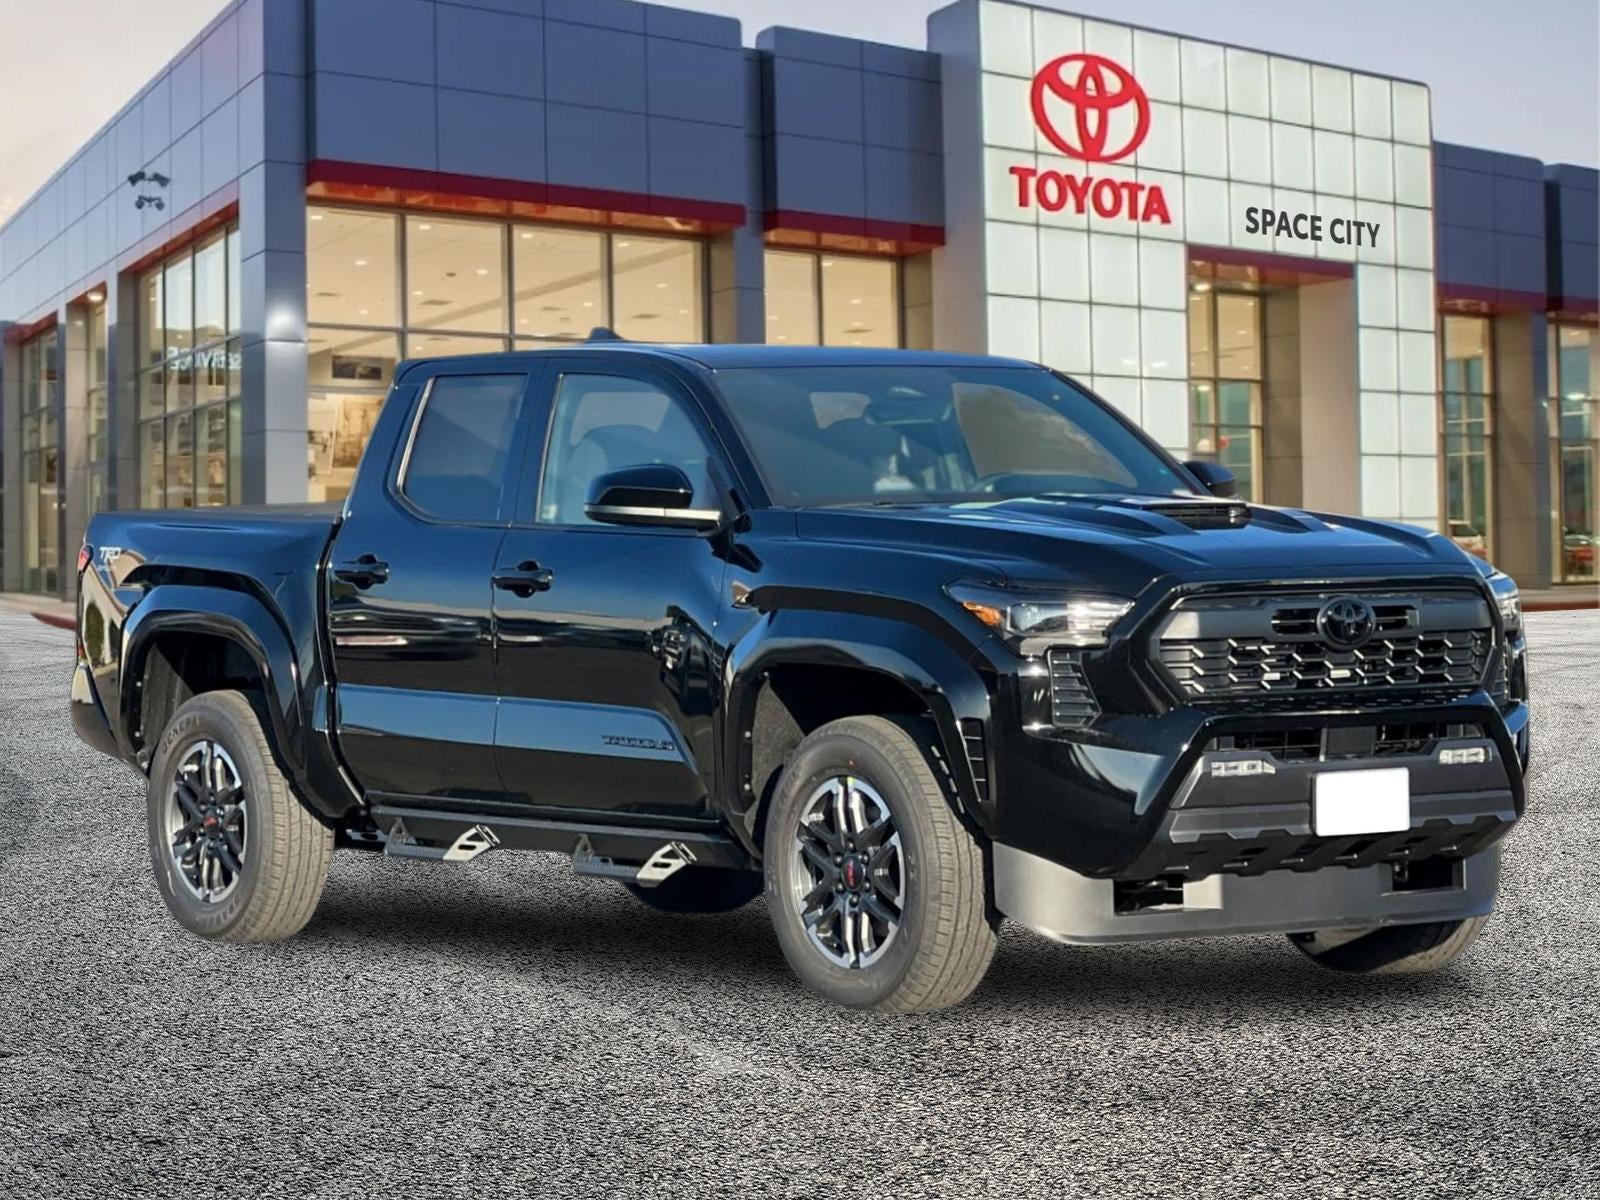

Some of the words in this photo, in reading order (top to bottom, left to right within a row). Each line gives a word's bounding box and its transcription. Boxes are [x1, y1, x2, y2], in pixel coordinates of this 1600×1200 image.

[1009, 166, 1171, 225] TOYOTA
[1245, 207, 1323, 242] SPACE
[1329, 218, 1381, 248] CITY
